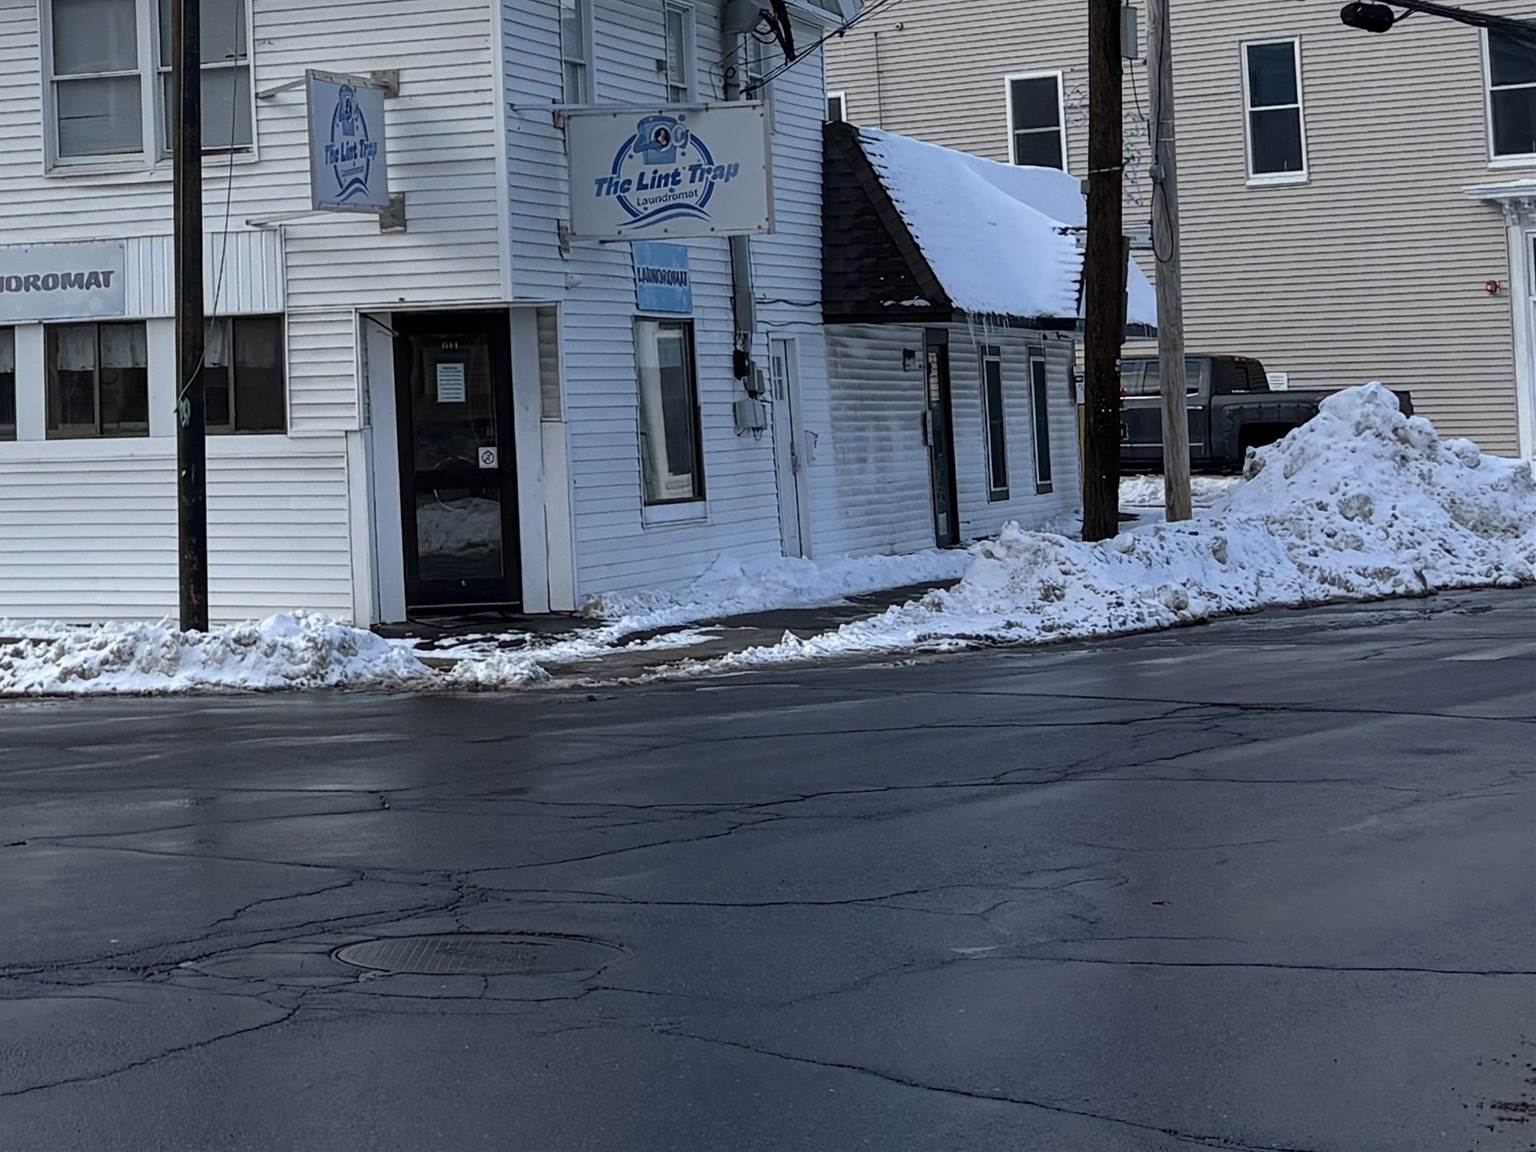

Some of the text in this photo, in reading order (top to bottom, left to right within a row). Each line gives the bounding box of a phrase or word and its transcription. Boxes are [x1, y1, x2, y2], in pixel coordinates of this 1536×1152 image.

[594, 161, 740, 197] The Lint Trap
[636, 189, 699, 207] Laundromat
